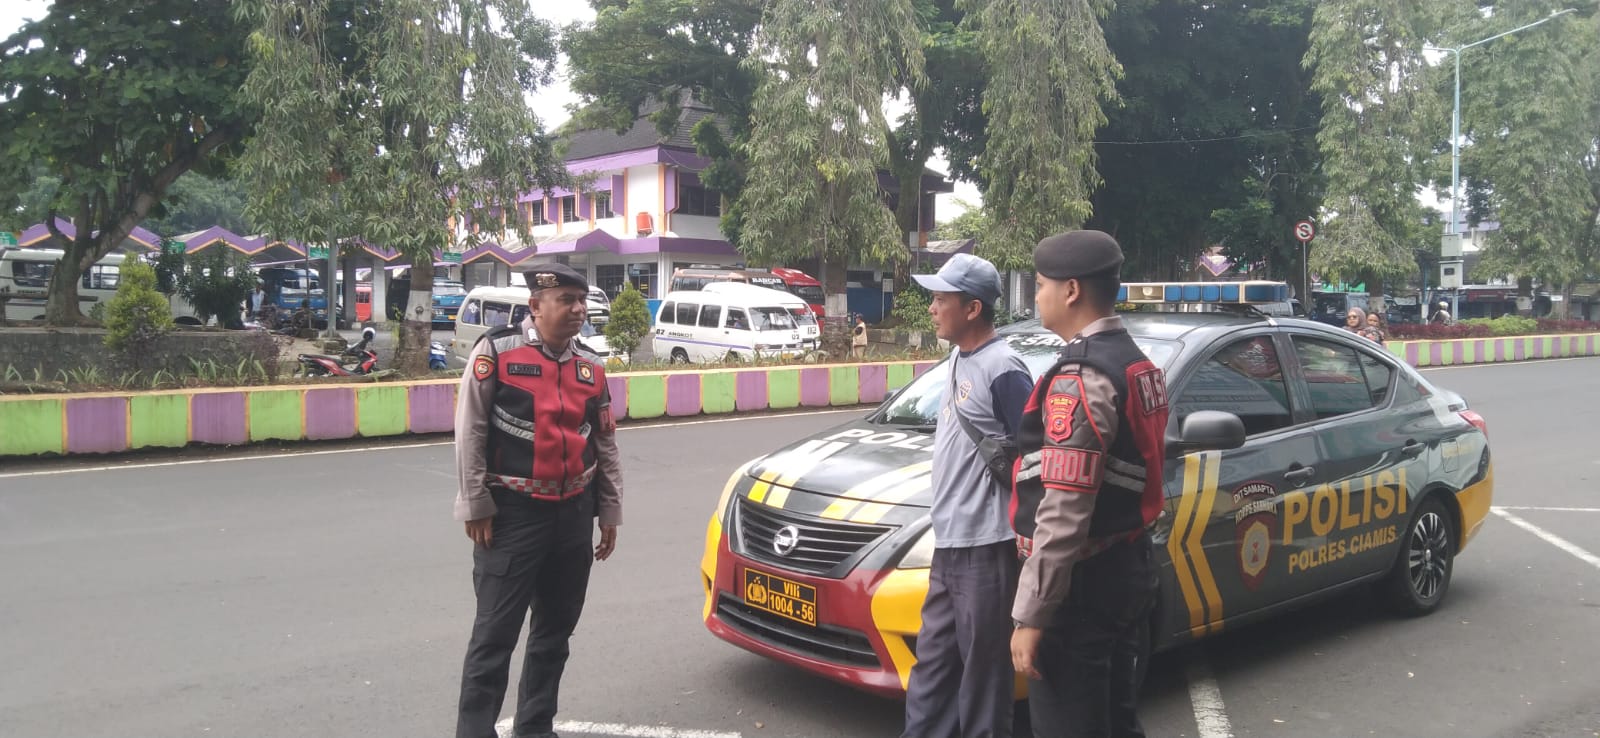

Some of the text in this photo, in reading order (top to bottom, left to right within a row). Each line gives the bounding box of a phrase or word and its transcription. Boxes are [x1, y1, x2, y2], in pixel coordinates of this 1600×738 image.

[1282, 467, 1407, 546] POLISI
[1288, 525, 1397, 575] POLRES CIAMIS
